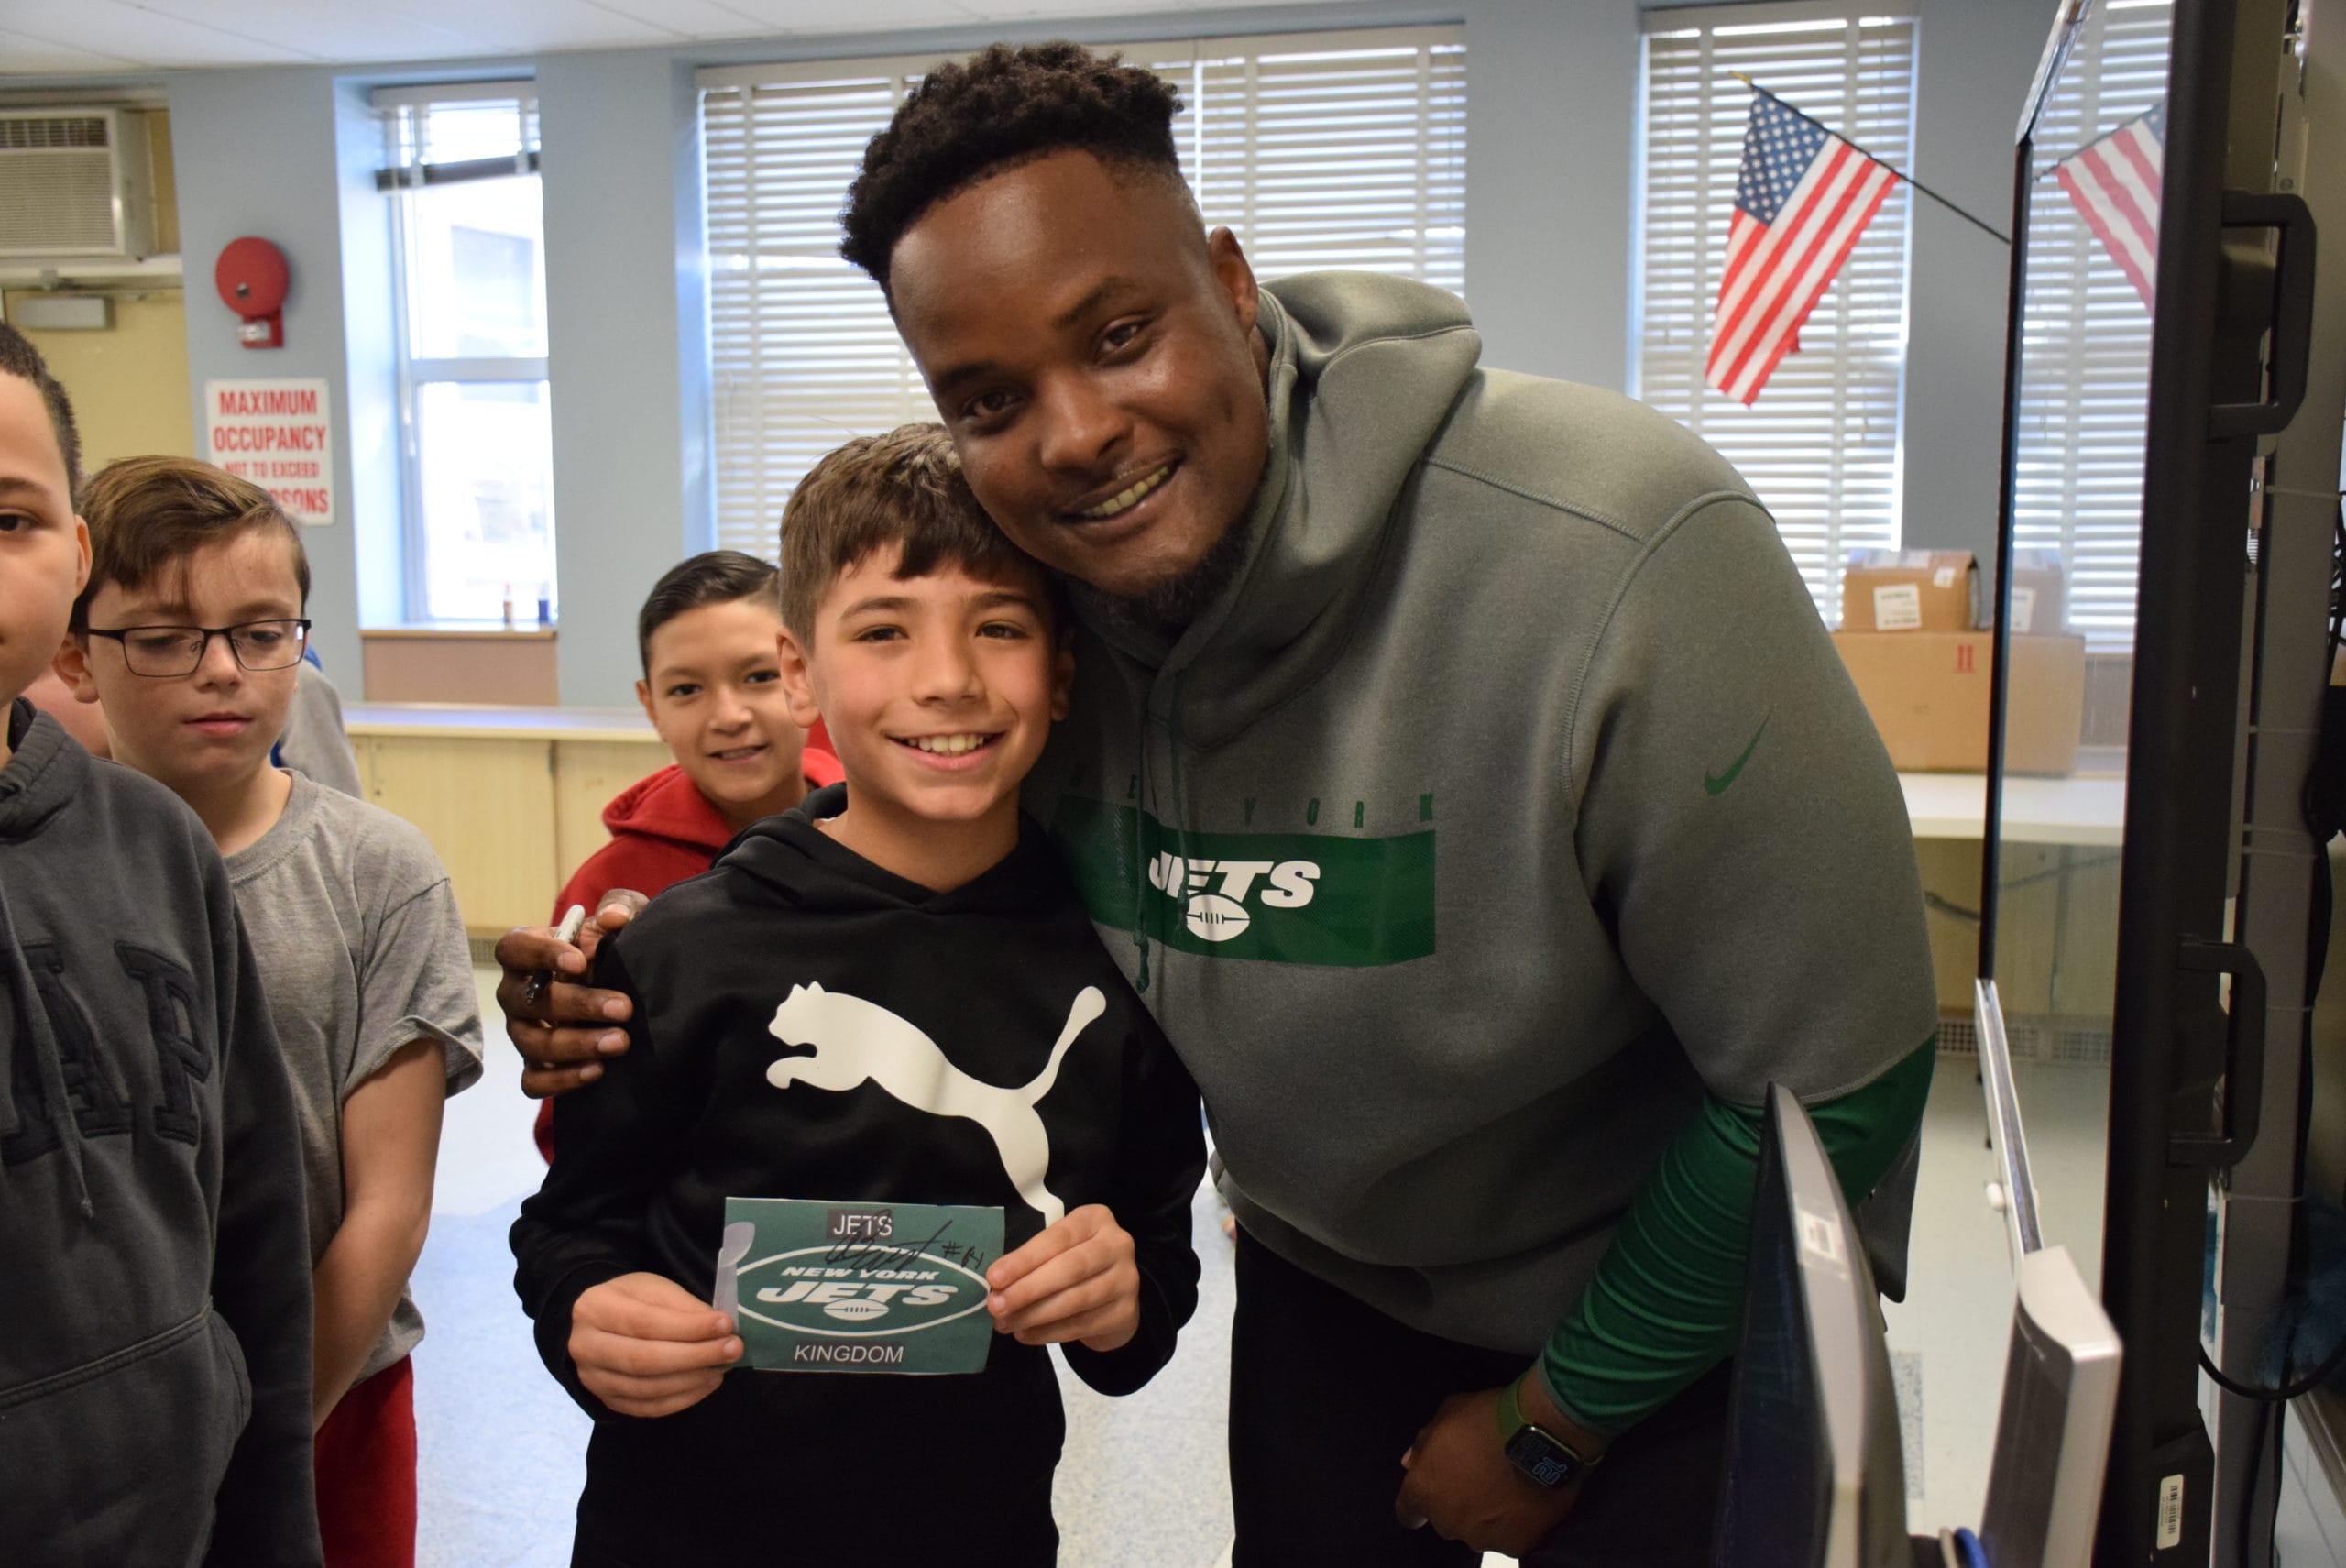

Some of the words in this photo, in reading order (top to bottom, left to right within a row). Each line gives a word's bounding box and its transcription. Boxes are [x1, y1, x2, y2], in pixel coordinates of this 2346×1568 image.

[220, 391, 316, 413] MAXIMUM
[214, 426, 325, 451] OCCUPANCY
[253, 461, 267, 477] TO
[272, 460, 319, 477] EXCEED
[1149, 850, 1321, 908] JETS
[833, 1214, 893, 1237] JETS
[781, 1266, 853, 1278] NEW
[858, 1268, 940, 1280] YORK
[756, 1281, 959, 1306] JETS
[795, 1344, 904, 1364] KINGDOM
